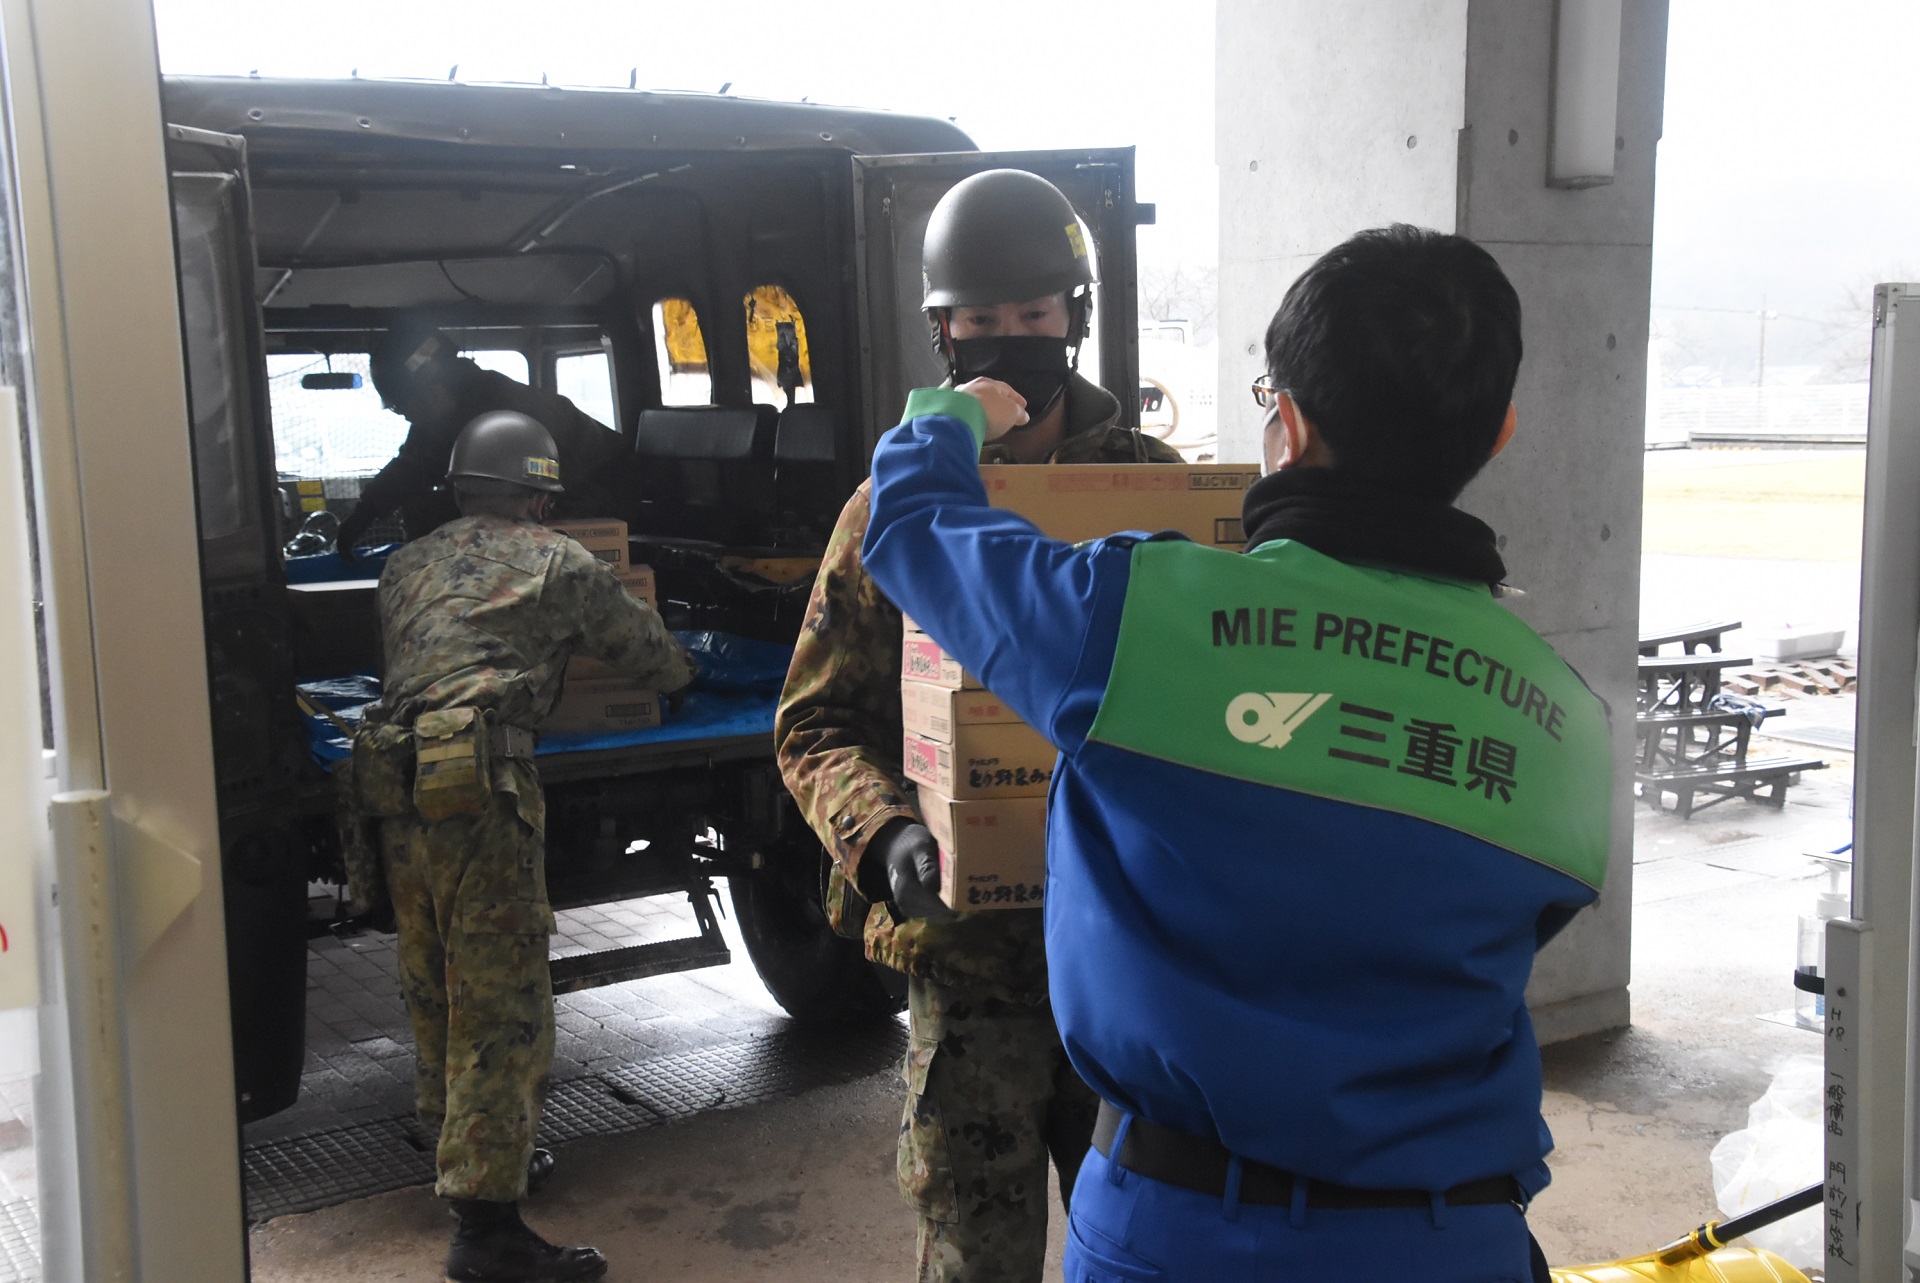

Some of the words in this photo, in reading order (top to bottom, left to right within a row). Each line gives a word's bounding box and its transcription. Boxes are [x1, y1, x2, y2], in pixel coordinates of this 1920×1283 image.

[1211, 607, 1298, 648] MIE
[1313, 612, 1567, 743] PREFECTURE
[1328, 701, 1518, 805] 三重県
